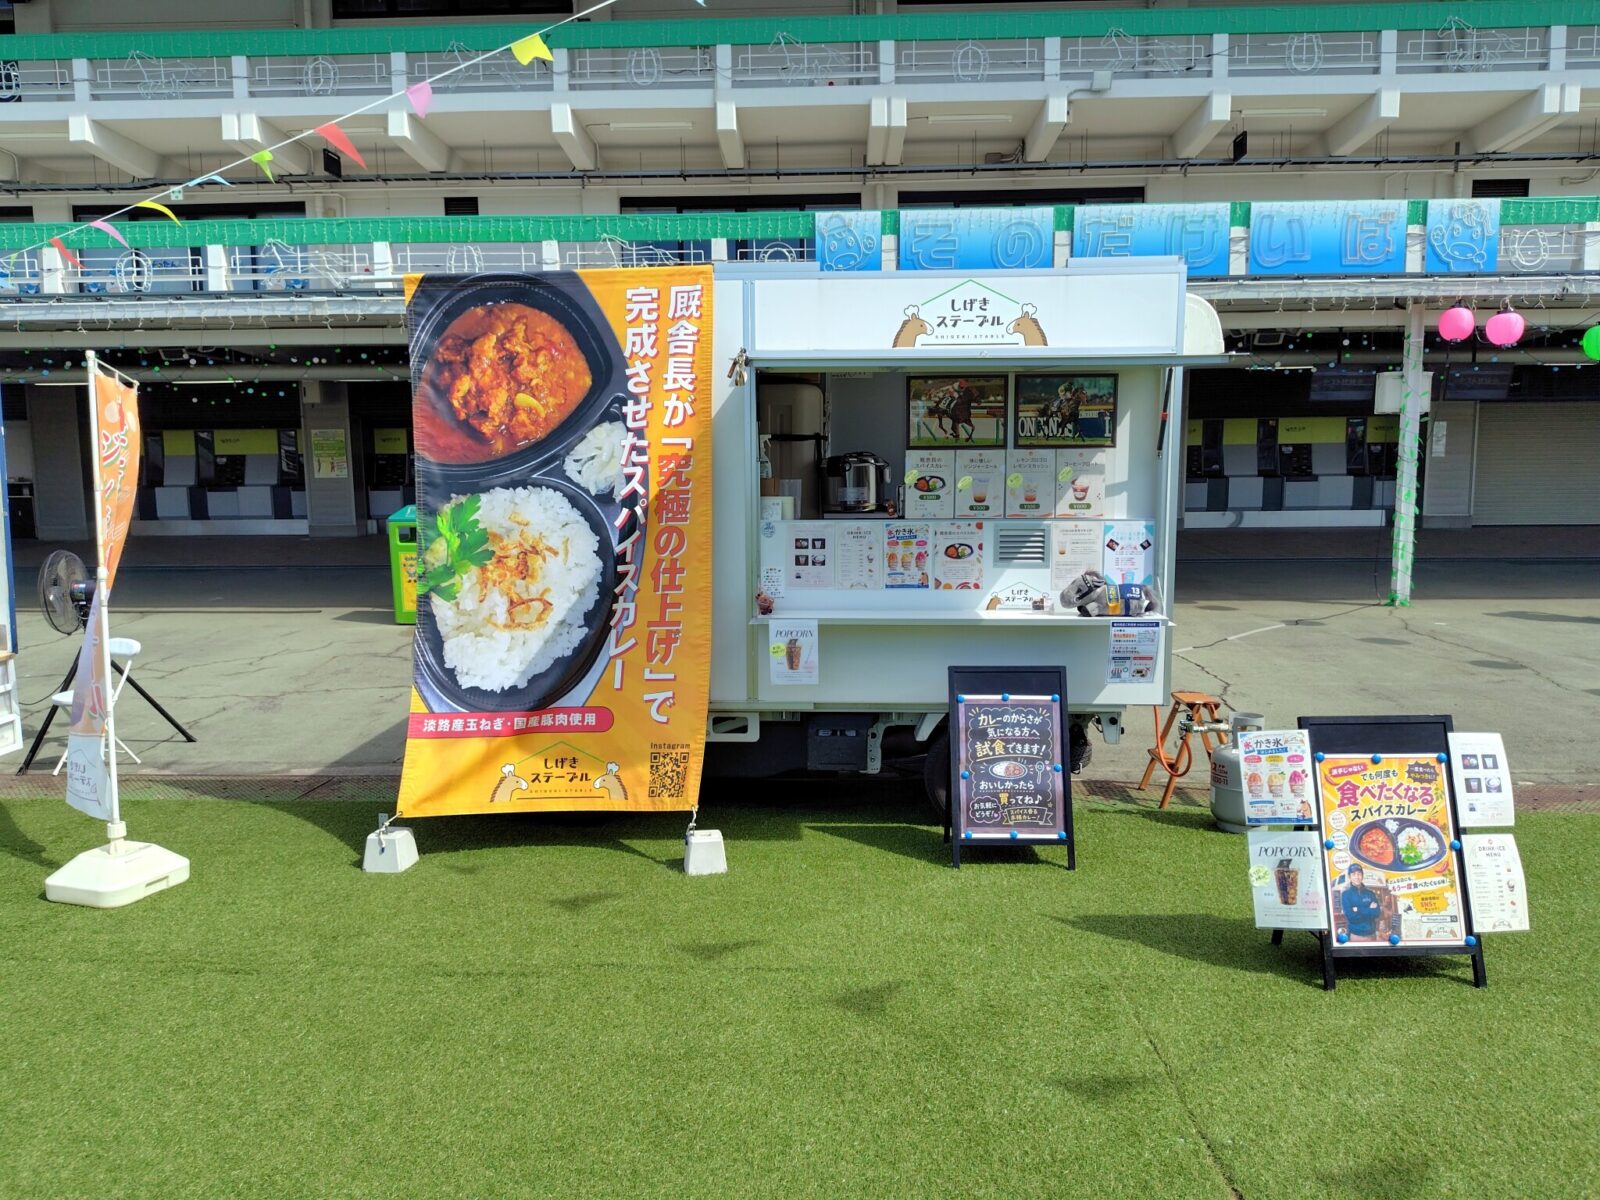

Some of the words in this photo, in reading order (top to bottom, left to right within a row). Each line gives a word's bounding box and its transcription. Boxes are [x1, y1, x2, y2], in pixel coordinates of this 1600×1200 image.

[951, 297, 990, 312] しげき
[936, 315, 1004, 328] ステーブル
[609, 286, 660, 691] 完成させたスパイスカレー
[1131, 586, 1140, 595] 13
[775, 629, 813, 638] POPCORN
[423, 712, 597, 732] 淡路産玉ねぎ・国産豚肉使用
[978, 713, 1043, 726] カレーのからさが
[987, 727, 1040, 737] 気になる方へ
[975, 739, 1046, 757] 試食できます!
[1254, 738, 1283, 749] かき氷
[544, 756, 579, 769] しげき
[531, 772, 592, 783] ステーブル
[979, 780, 1035, 790] おいしかったら
[1336, 780, 1435, 808] 食べたくなる
[1351, 804, 1427, 822] スパイスカレー
[1258, 846, 1314, 857] POPCORN
